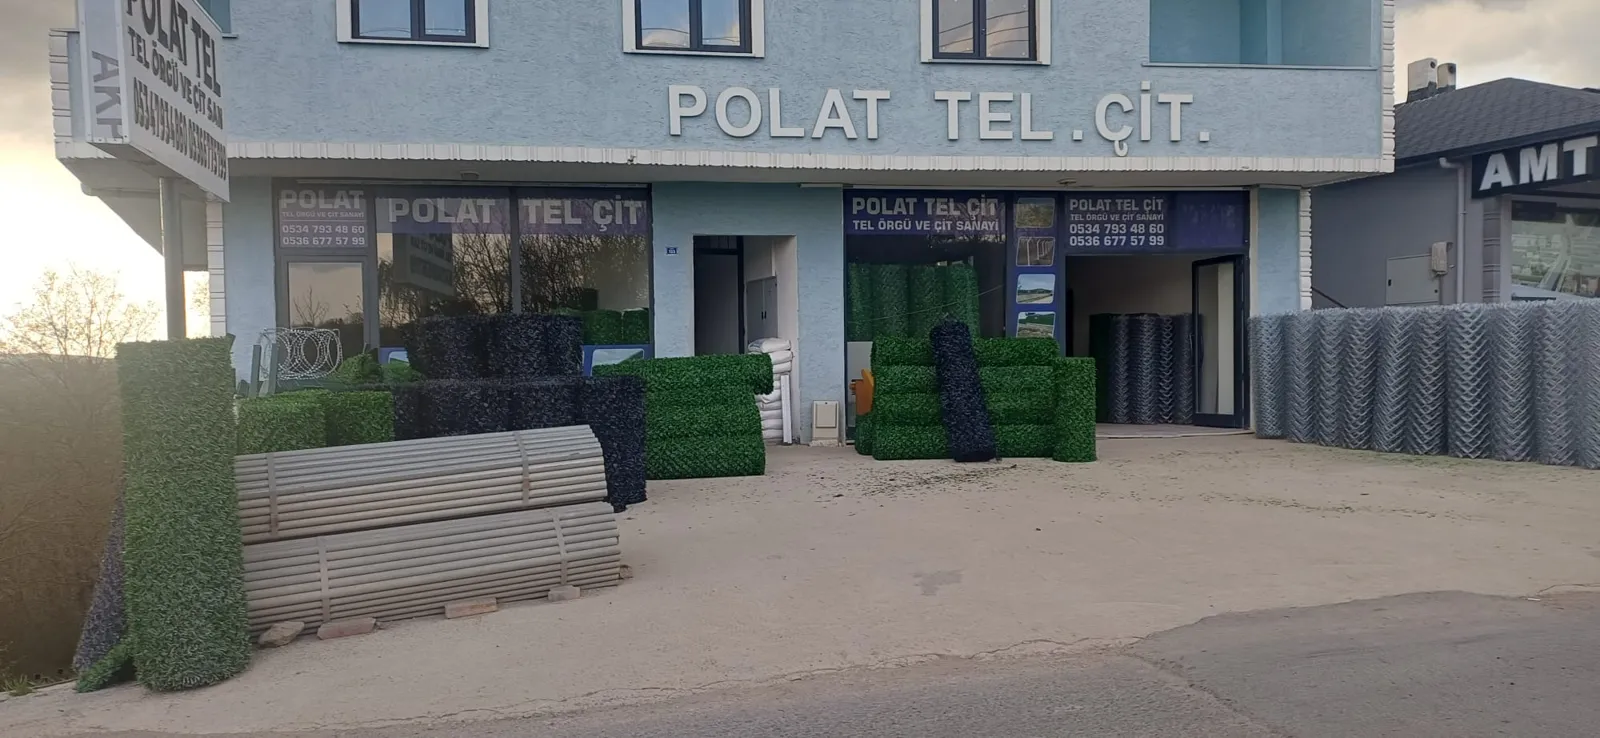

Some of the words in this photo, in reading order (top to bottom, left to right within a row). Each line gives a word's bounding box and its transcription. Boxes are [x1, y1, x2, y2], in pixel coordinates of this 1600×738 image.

[127, 0, 188, 67] OLAT
[191, 16, 222, 98] TEL
[128, 25, 150, 70] TEL
[152, 39, 179, 93] ÖRGÜ
[179, 71, 193, 105] VE
[193, 81, 206, 115] ÇİT
[207, 96, 223, 130] SAN
[668, 84, 891, 140] POLAT
[1478, 135, 1598, 192] AMT
[280, 189, 365, 209] POLAT
[852, 197, 917, 215] POLAT
[923, 198, 961, 216] TEL
[966, 194, 998, 221] ÇİT
[1069, 198, 1112, 211] POLAT
[1116, 199, 1139, 211] TEL
[1143, 196, 1164, 214] ÇİT
[296, 210, 315, 218] ÖRGÜ
[327, 211, 339, 219] ÇİT
[340, 211, 365, 219] SANAYİ
[388, 197, 496, 224] POLAT
[522, 199, 582, 226] TEL
[592, 195, 642, 232] ÇİT
[1070, 213, 1085, 221] TEL
[1086, 212, 1107, 221] ÖRGÜ
[1109, 213, 1120, 221] VE
[1122, 212, 1134, 223] ÇİT
[1136, 212, 1164, 221] SANAYİ
[282, 225, 309, 234] 0534
[312, 225, 332, 234] 793
[335, 225, 348, 234] 48
[351, 225, 365, 234] 60
[852, 220, 874, 231] TEL
[877, 218, 912, 231] ÖRGÜ
[915, 220, 930, 231] VE
[934, 218, 953, 232] ÇİT
[956, 218, 999, 231] SANAYİ
[1069, 223, 1100, 234] 0534
[1104, 223, 1126, 234] 793
[1130, 223, 1145, 234] 48
[1149, 223, 1164, 234] 60
[282, 237, 309, 246] 0536
[312, 237, 332, 246] 677
[335, 237, 348, 246] 57
[351, 237, 365, 246] 99
[1069, 235, 1100, 246] 0536
[1104, 235, 1126, 246] 677
[1130, 235, 1145, 246] 57
[1149, 235, 1164, 246] 99
